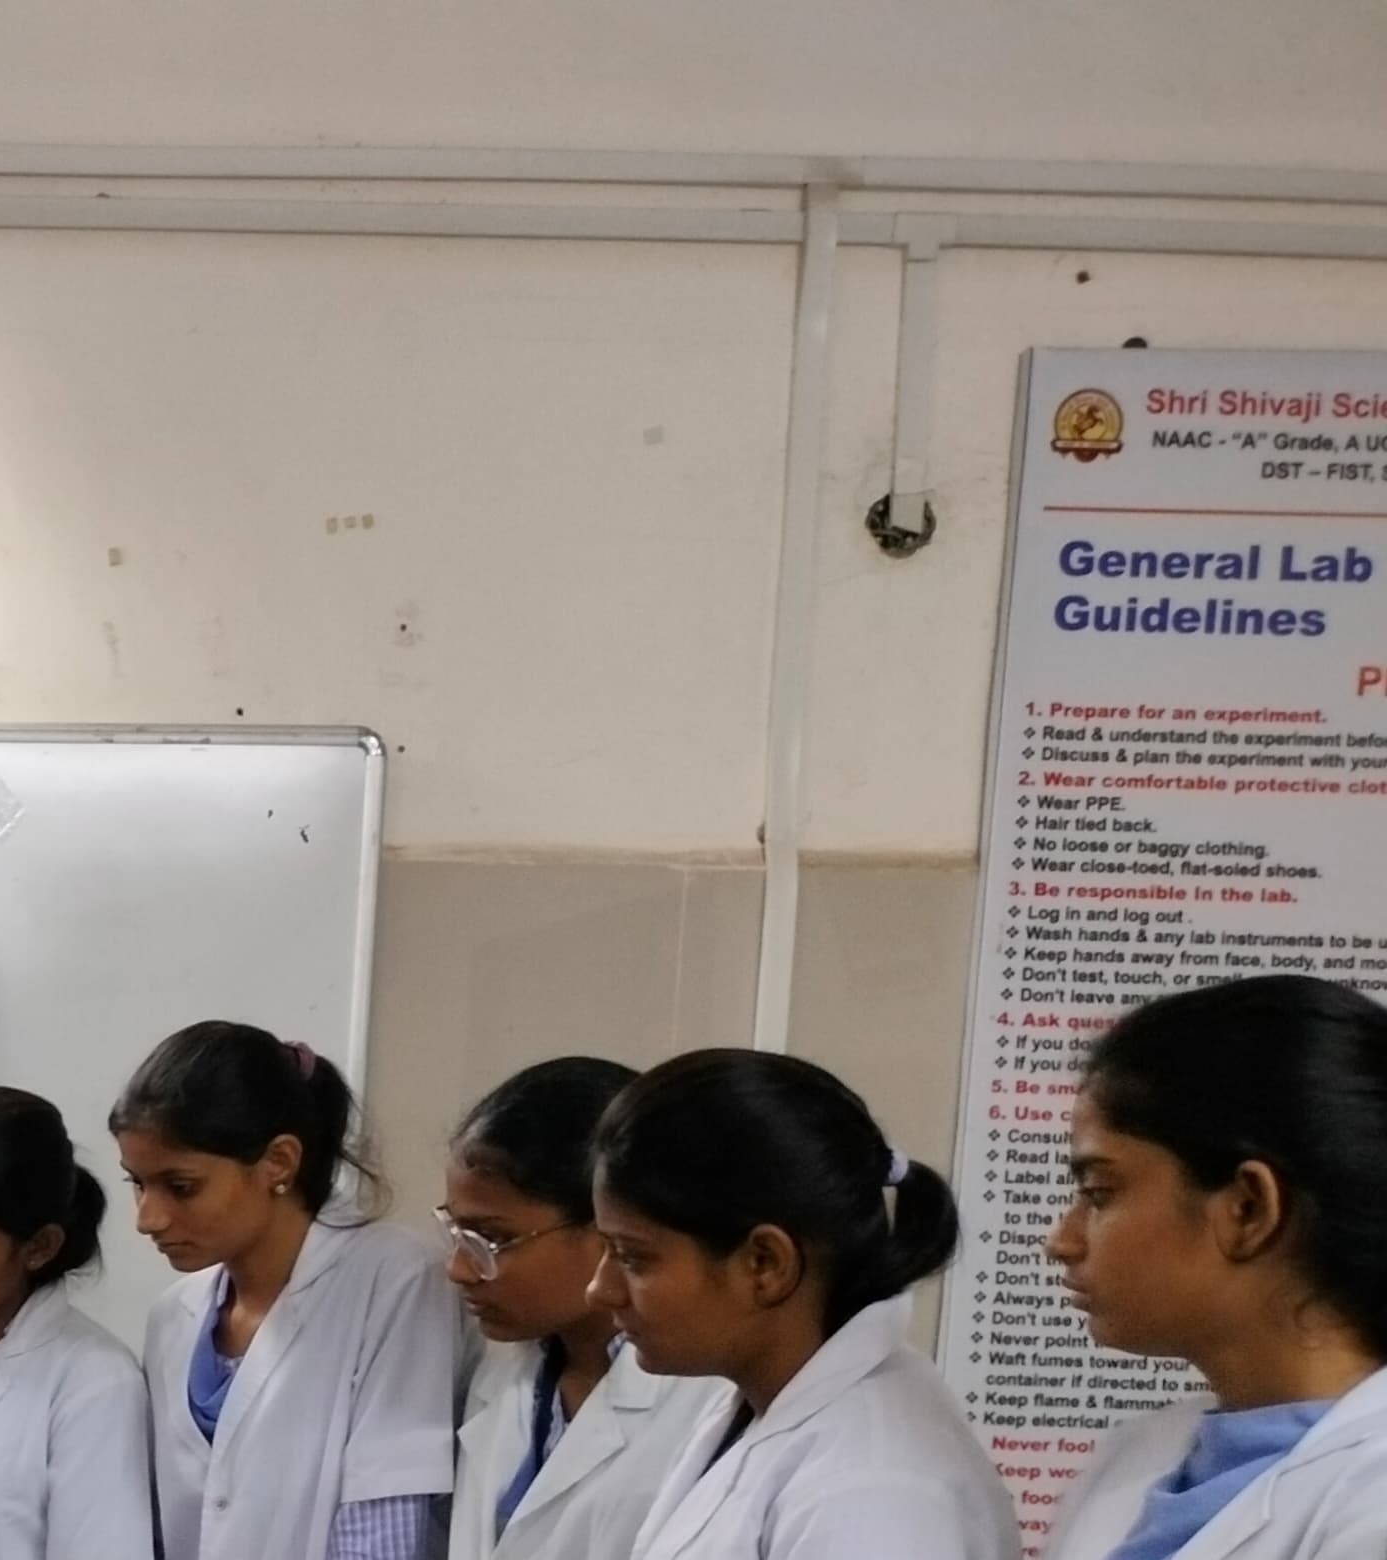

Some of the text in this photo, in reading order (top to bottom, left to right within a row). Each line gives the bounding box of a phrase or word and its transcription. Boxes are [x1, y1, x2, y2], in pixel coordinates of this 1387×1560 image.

[1147, 388, 1208, 415] Shri
[1219, 390, 1323, 424] Shivaji
[1152, 431, 1339, 453] NAAC Grade,
[1262, 462, 1303, 479] DST
[1059, 541, 1373, 582] General Lab
[1054, 595, 1326, 637] Guidelines
[1050, 703, 1328, 724] Prepare for an experiment.
[1043, 726, 1341, 748] Read understand the experiment
[1041, 747, 1345, 768] Discuss plan the experiment with
[1044, 772, 1340, 794] Wear comfortable protective
[1037, 795, 1080, 810] Wear
[1035, 816, 1157, 833] Hair tied back.
[1033, 837, 1269, 860] No loose baggy clothing.
[1032, 857, 1322, 879] Wear close-toed, flat-soled shoes.
[1034, 882, 1298, 904] Be responsible the lab.
[1028, 905, 1183, 925] Log and log out
[1026, 926, 1324, 948] Wash hands any lab instruments
[1024, 946, 1068, 964] Keep
[1073, 948, 1125, 963] hands
[1131, 951, 1175, 968] away
[1180, 951, 1219, 965] from
[1225, 952, 1266, 968] face,
[1271, 954, 1317, 971] body,
[1323, 956, 1355, 969] and
[1022, 967, 1066, 982] Don't
[1020, 988, 1114, 1004] Don't leave
[1022, 1013, 1059, 1028] Ask
[1031, 1059, 1061, 1073] you
[1015, 1081, 1040, 1095] Be
[1014, 1106, 1053, 1121] Use
[1006, 1149, 1049, 1164] Read
[1004, 1171, 1050, 1185] Label
[1003, 1189, 1041, 1205] Take
[996, 1250, 1040, 1265] Don't
[995, 1271, 1039, 1286] Don't
[993, 1291, 1055, 1309] Always
[992, 1311, 1036, 1326] Don't
[990, 1332, 1089, 1350] Never point
[989, 1352, 1148, 1370] Waft fumes toward
[985, 1373, 1157, 1391] container directed
[985, 1391, 1080, 1409] Keep flame
[983, 1411, 1109, 1429] Keep electrical
[991, 1436, 1050, 1452] Never
